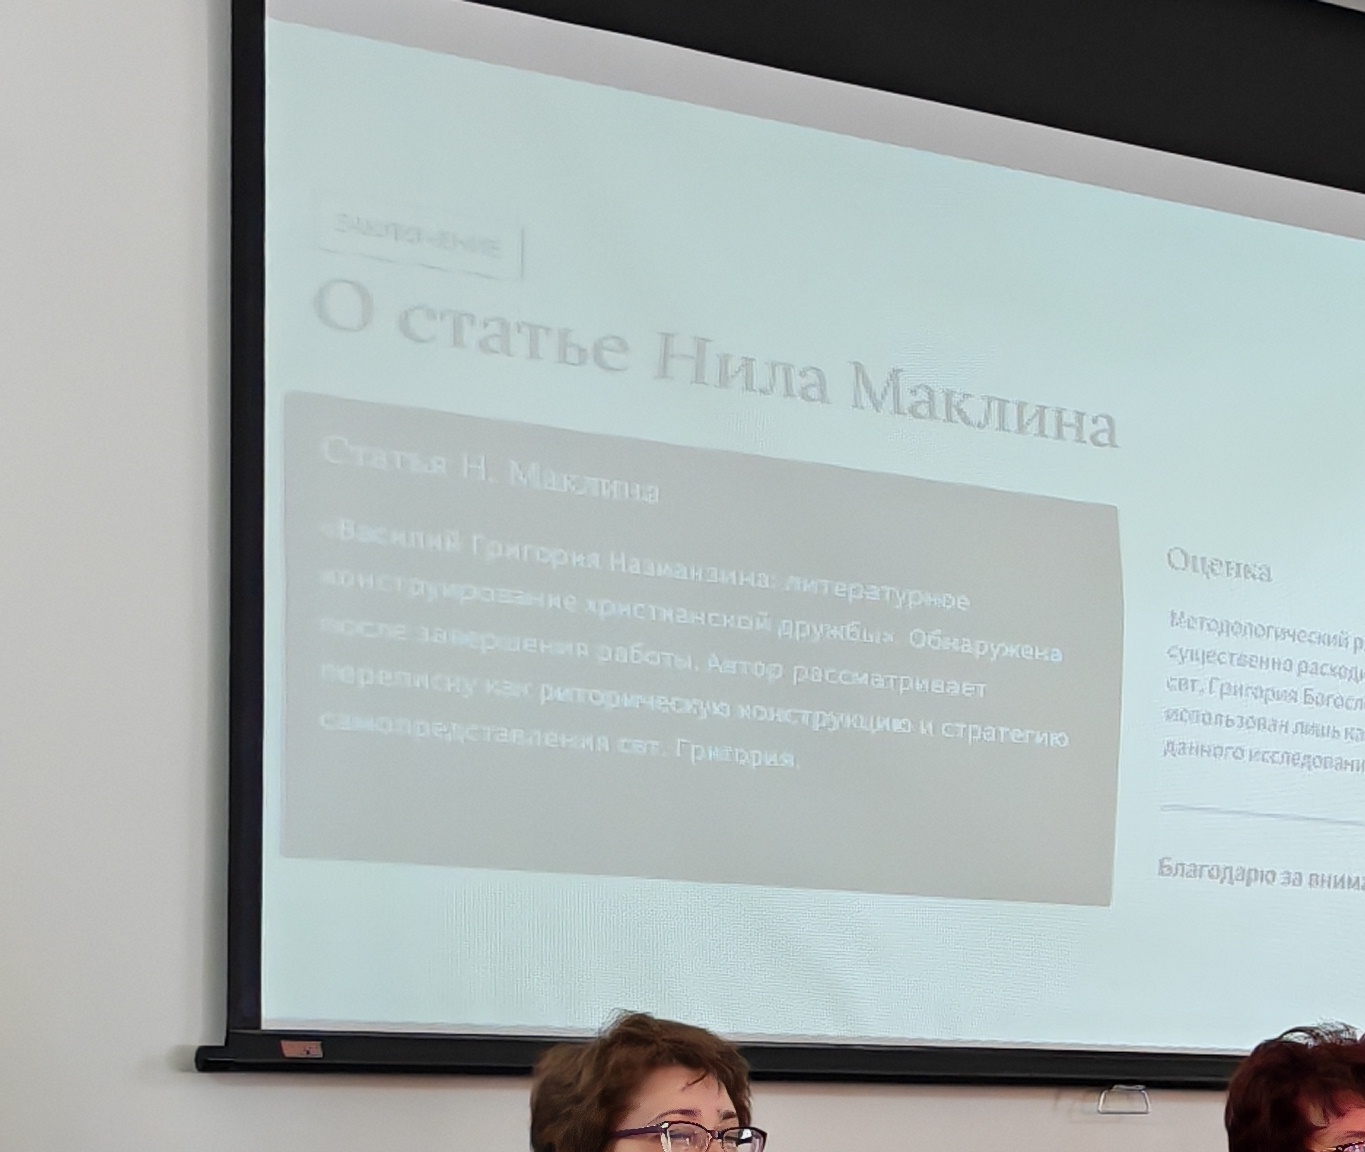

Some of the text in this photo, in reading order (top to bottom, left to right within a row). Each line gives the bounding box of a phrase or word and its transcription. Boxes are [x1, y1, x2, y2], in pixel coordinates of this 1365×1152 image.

[313, 278, 1121, 449] О статье Нила Маклина
[322, 434, 447, 475] Статья
[509, 458, 660, 505] Маклина
[1166, 546, 1272, 583] Оценка
[784, 573, 971, 611] литературное
[909, 626, 1064, 663] Обнаружена
[1170, 609, 1350, 649] Методологический
[708, 651, 784, 683] Автор
[792, 664, 987, 699] рассматривает
[1166, 645, 1293, 672] существенно
[1208, 677, 1299, 705] Григория
[920, 718, 934, 736] и
[941, 720, 1070, 749] стратегию
[1164, 707, 1288, 734] использован
[1292, 720, 1340, 738] лишь
[1163, 739, 1245, 761] данного
[1157, 857, 1276, 887] Благодарю
[1280, 871, 1302, 888] за
